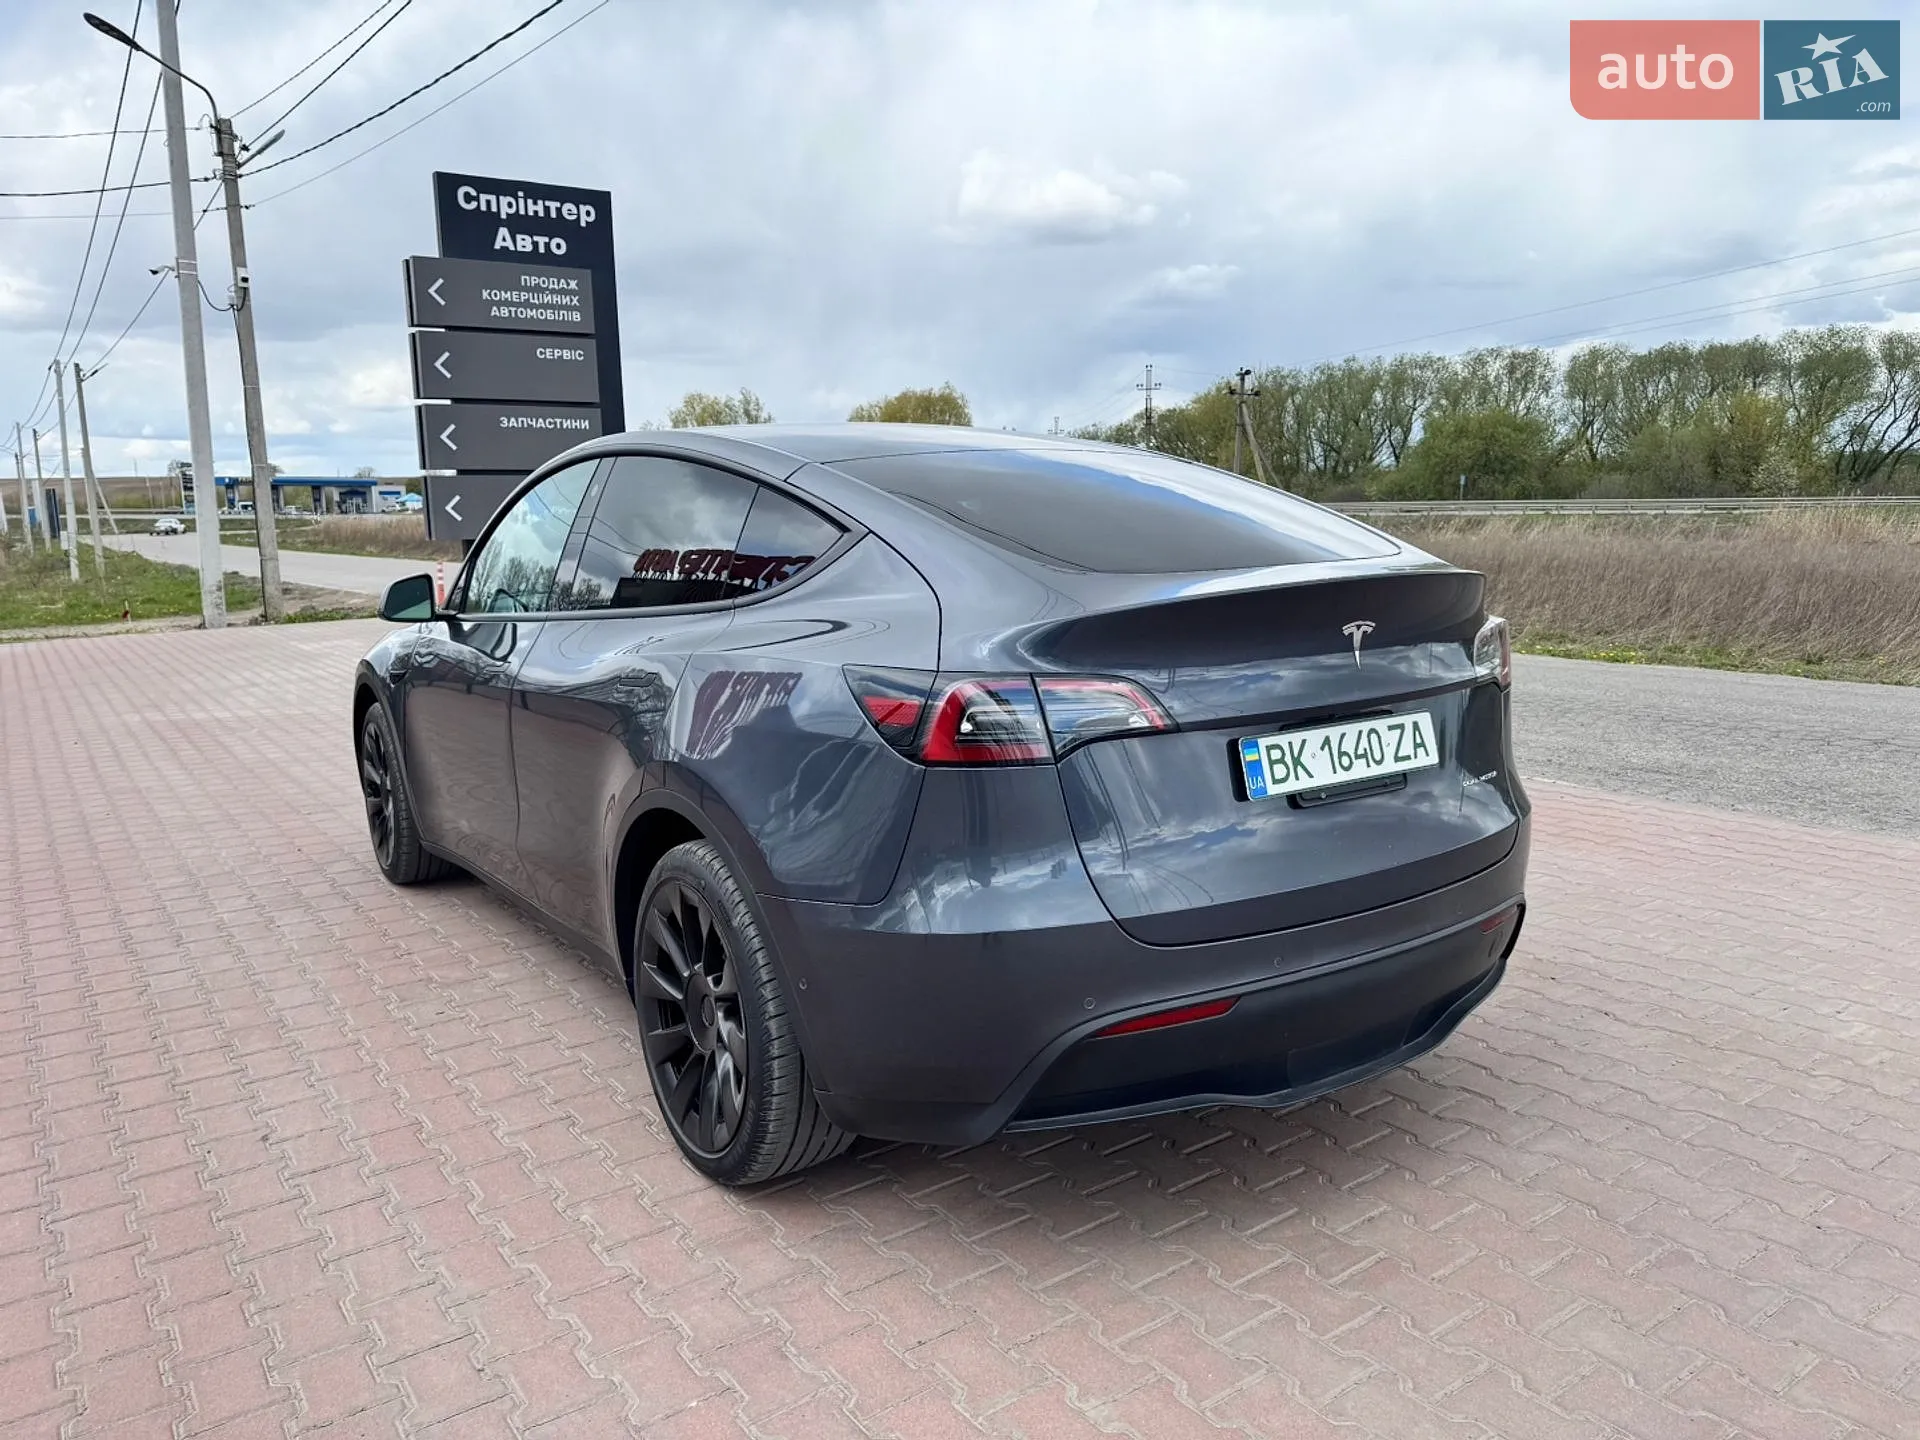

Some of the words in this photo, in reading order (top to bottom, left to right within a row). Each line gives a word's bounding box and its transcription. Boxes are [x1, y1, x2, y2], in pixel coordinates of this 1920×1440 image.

[456, 185, 596, 227] Спрінтер
[493, 227, 567, 255] Авто
[521, 275, 578, 290] ПРОДАЖ
[482, 289, 580, 306] КОМЕРЦІЙНИХ
[490, 306, 581, 322] АВТОМОБІЛІВ
[536, 348, 585, 361] СЕРВІС
[499, 417, 590, 430] ЗАПЧАСТИНИ
[1265, 738, 1314, 786] BK
[1320, 727, 1384, 775] 1640
[1387, 720, 1430, 764] ZA
[1249, 776, 1265, 790] UA
